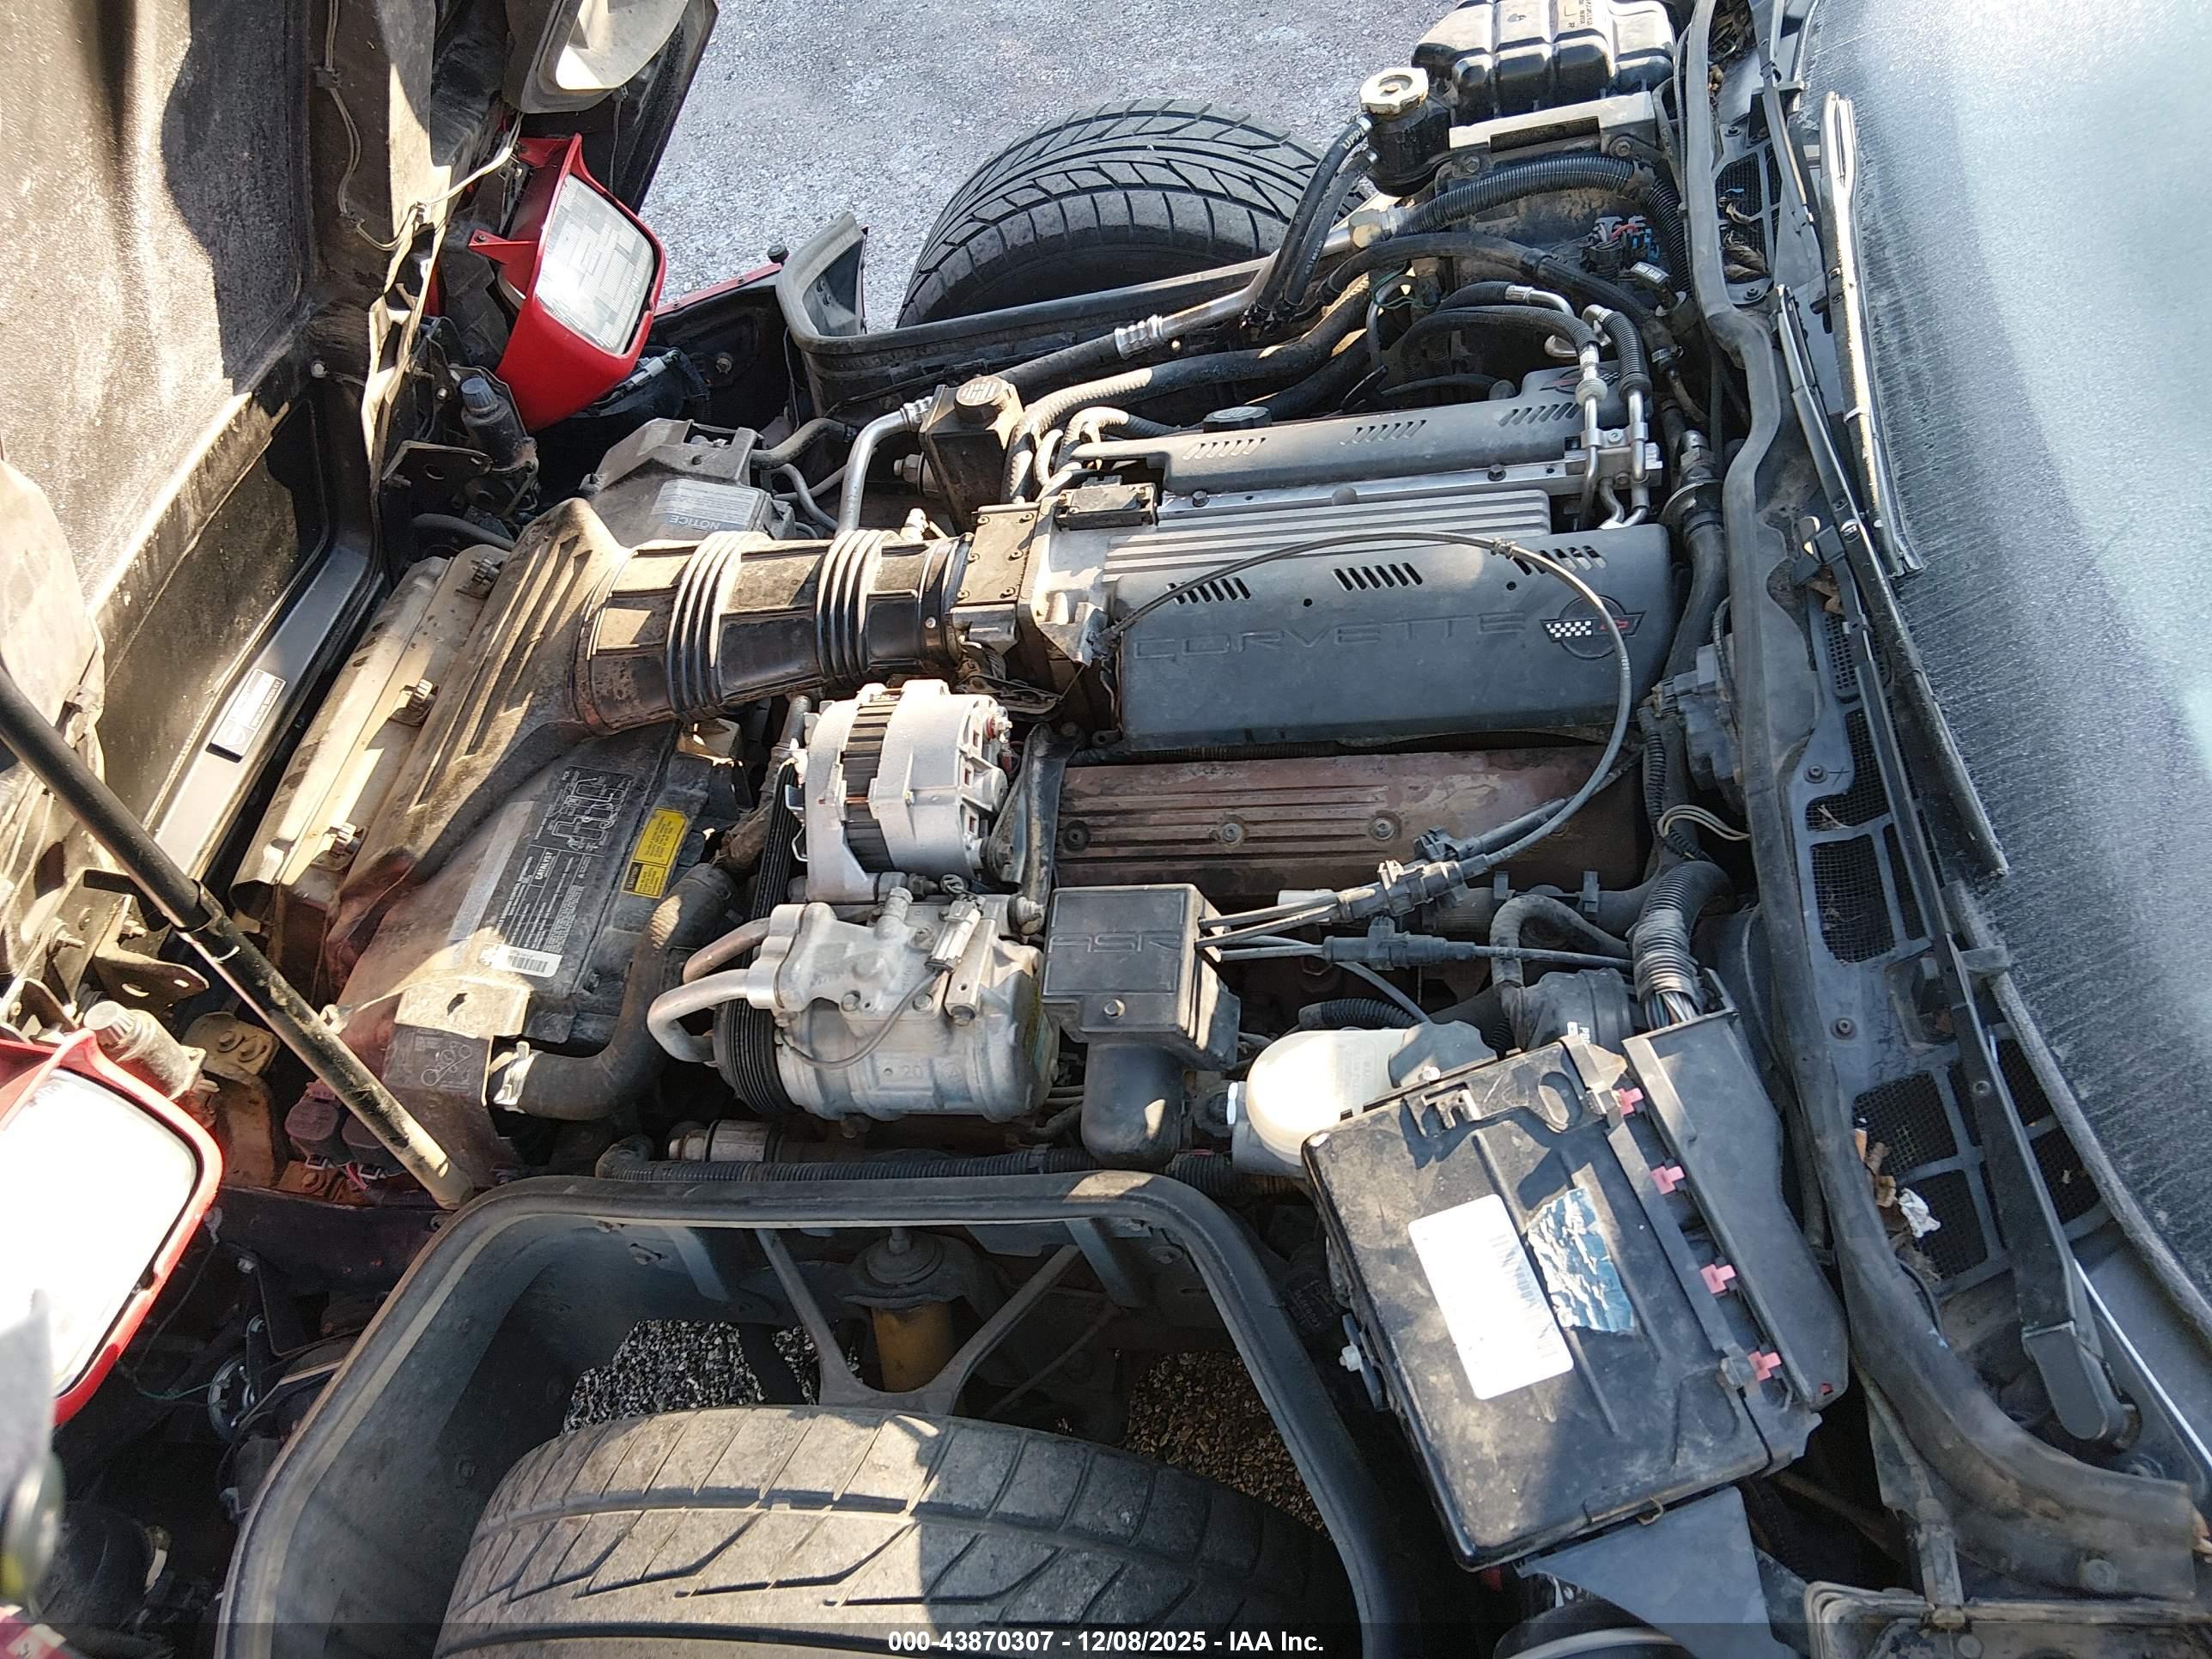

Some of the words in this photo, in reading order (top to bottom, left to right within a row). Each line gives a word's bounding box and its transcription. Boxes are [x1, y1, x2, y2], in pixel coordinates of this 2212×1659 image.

[668, 514, 721, 531] NOTICE
[1133, 611, 1527, 662] CORVETTE
[534, 851, 555, 880] CATALYST
[1047, 930, 1183, 954] ASR
